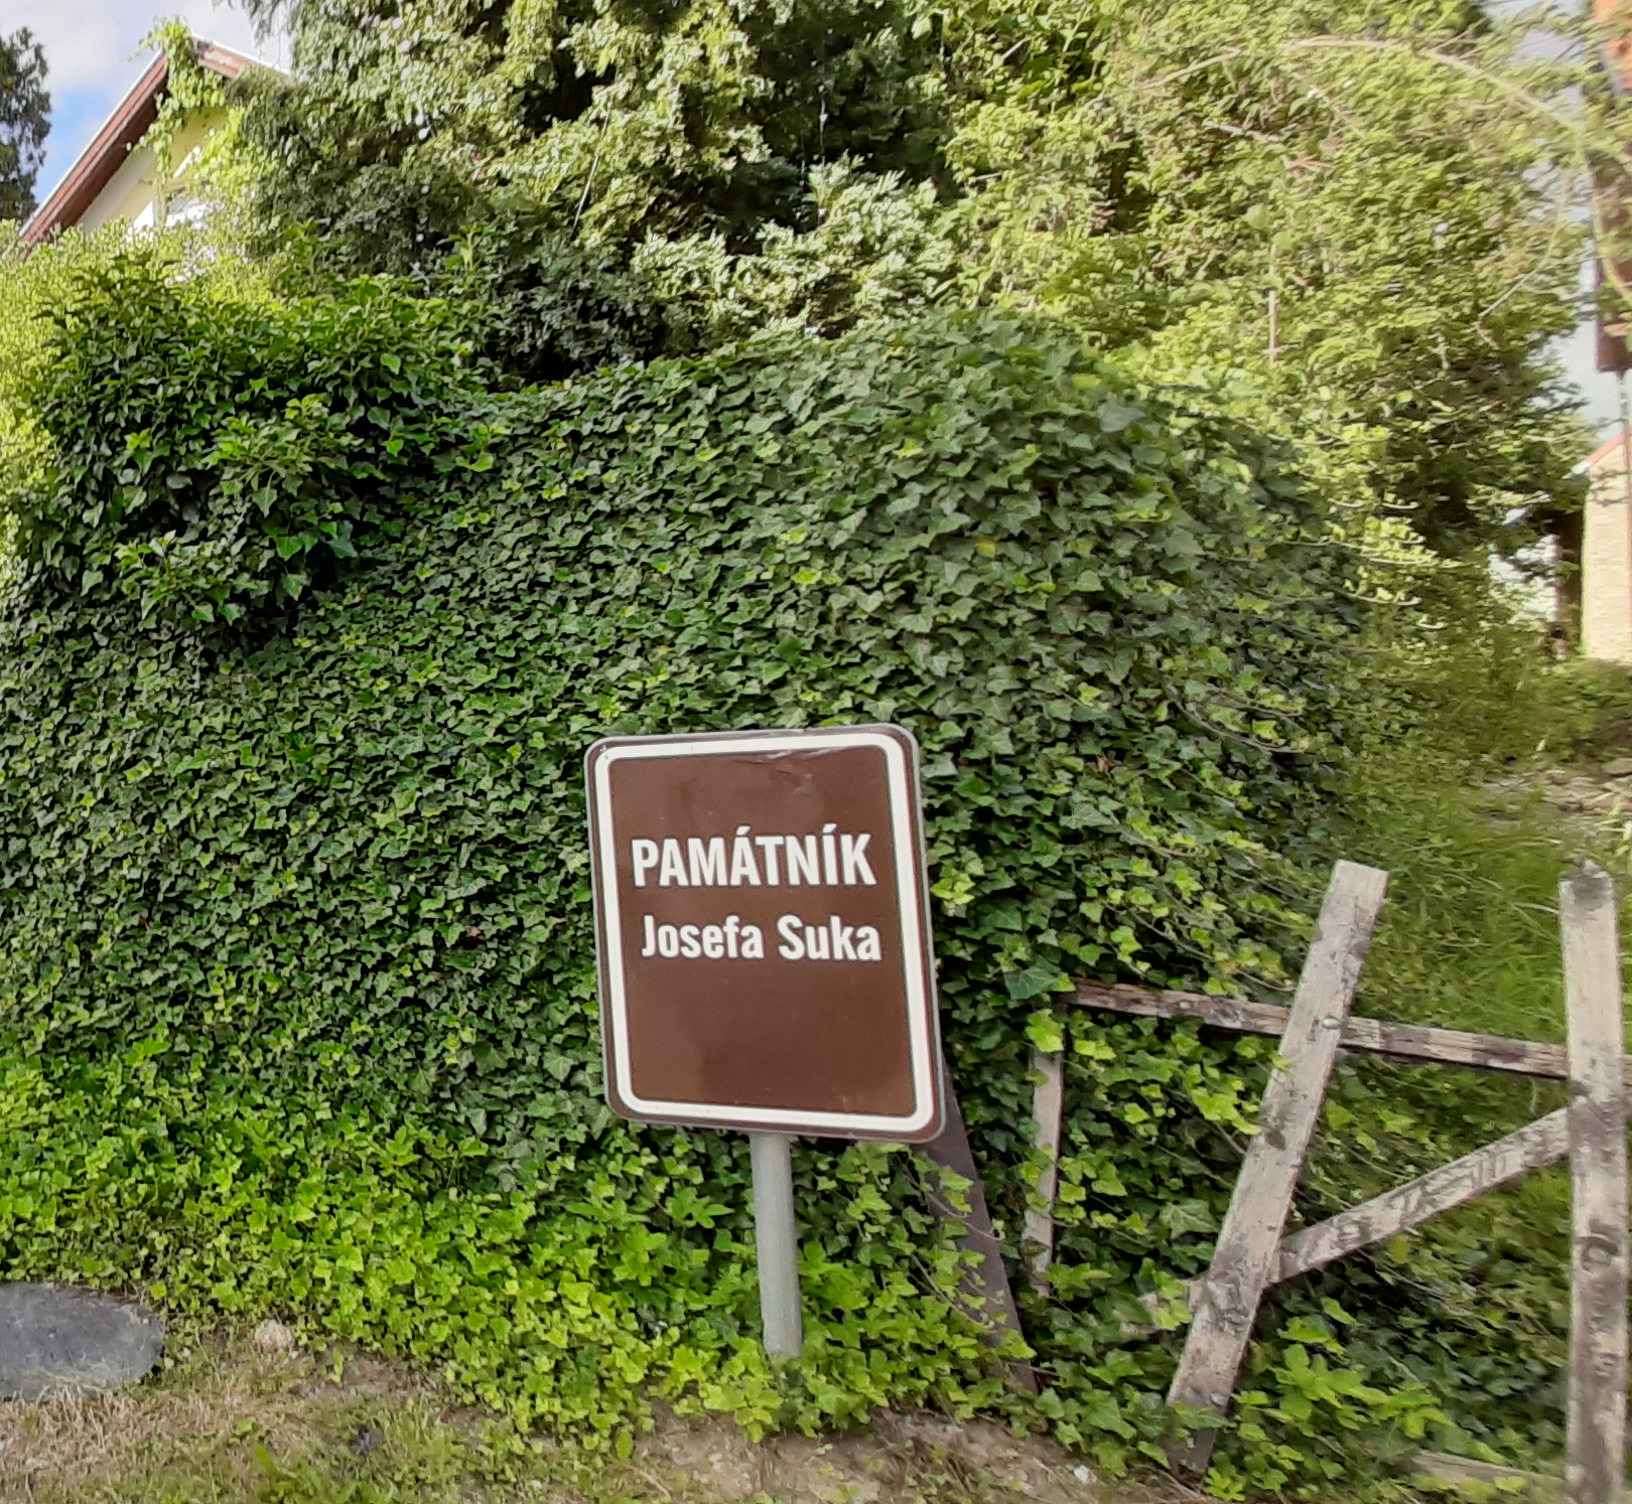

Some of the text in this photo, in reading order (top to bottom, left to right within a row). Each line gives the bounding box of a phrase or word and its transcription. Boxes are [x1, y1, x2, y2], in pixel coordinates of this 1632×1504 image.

[631, 823, 877, 888] PAMÁTNÍK
[641, 914, 882, 961] Josefa Suka
